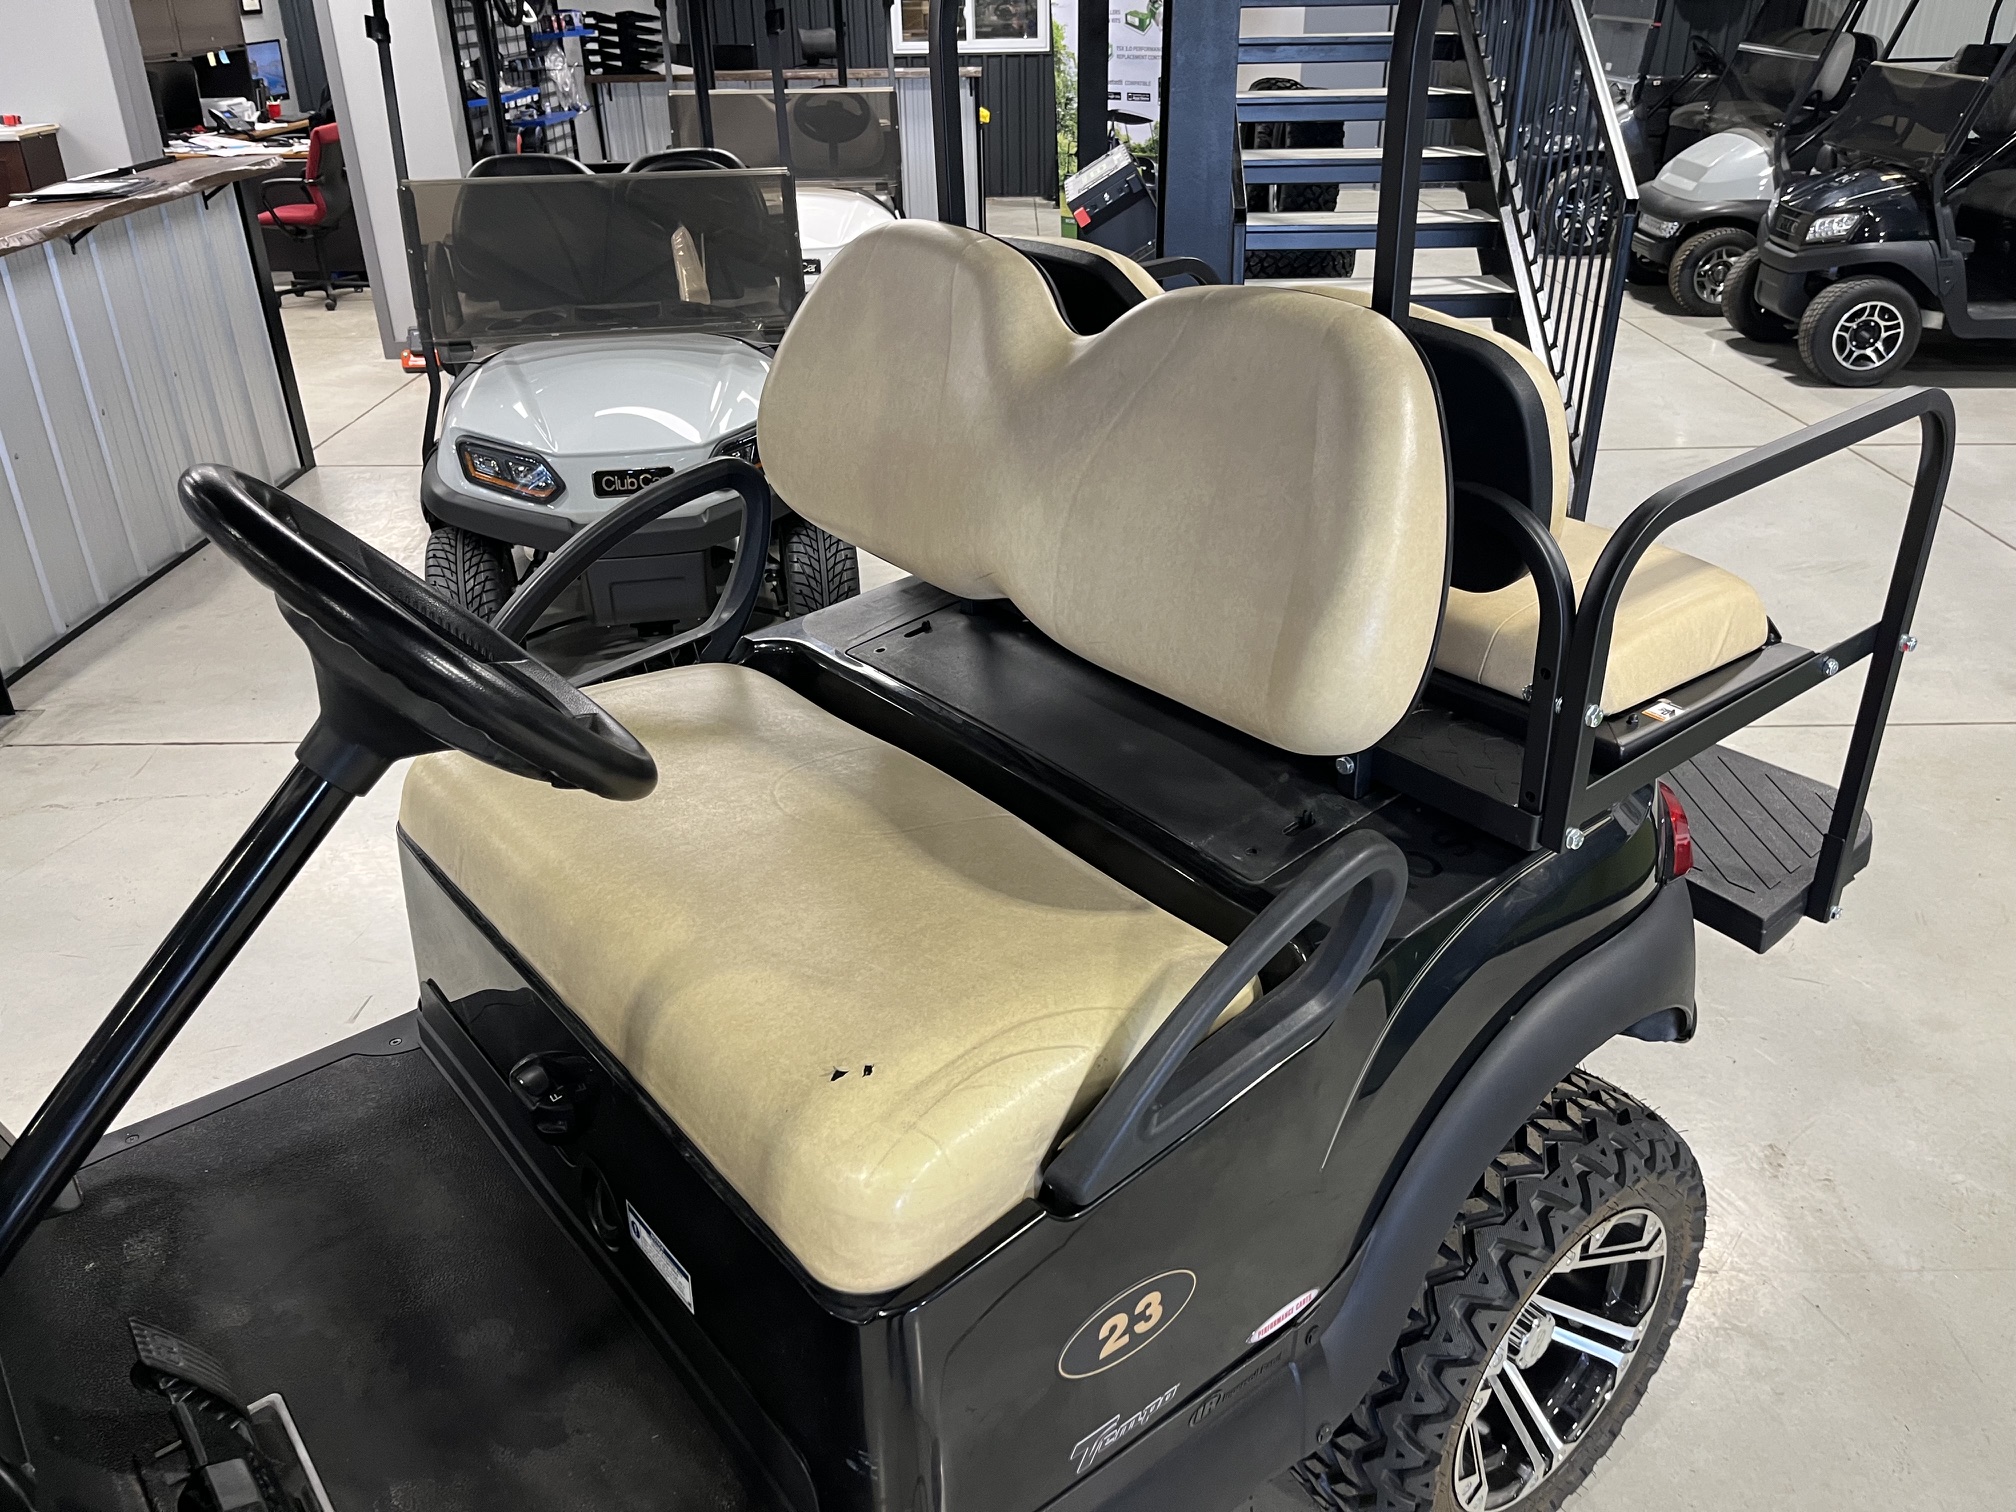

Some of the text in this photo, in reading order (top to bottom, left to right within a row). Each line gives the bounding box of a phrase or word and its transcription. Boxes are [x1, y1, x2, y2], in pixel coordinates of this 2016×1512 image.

[602, 473, 664, 491] Club Ca
[1098, 1290, 1164, 1361] 23
[1257, 1293, 1313, 1339] PERFORMANCE CARTS
[1069, 1382, 1181, 1475] Tempo
